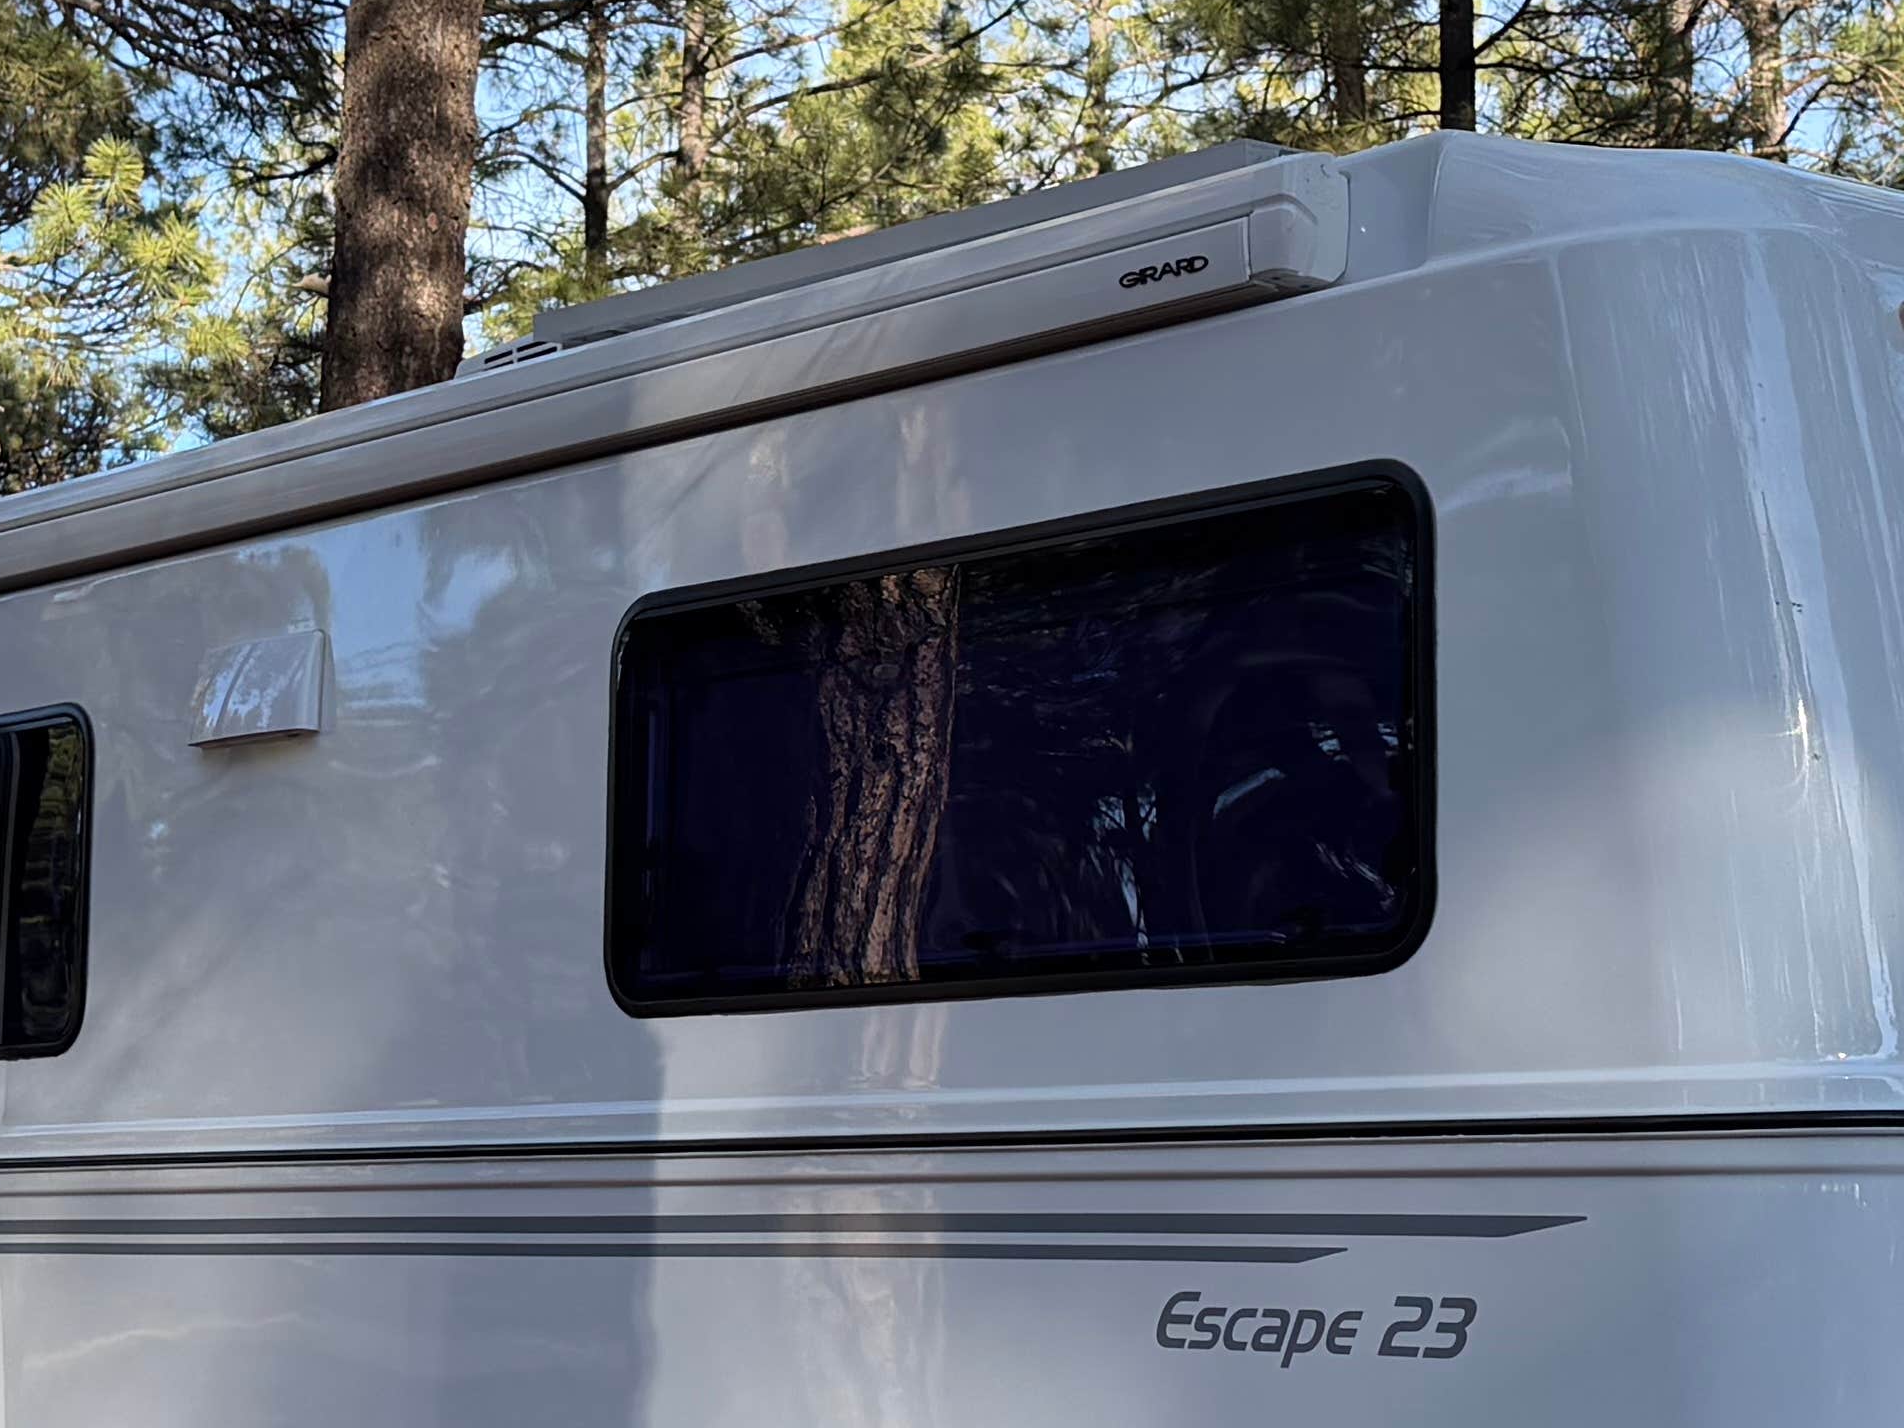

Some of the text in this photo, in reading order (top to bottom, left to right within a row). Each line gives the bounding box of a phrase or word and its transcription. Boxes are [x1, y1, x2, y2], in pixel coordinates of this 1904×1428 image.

[1119, 255, 1209, 288] GIRARD
[1156, 1291, 1478, 1368] Escape 23
